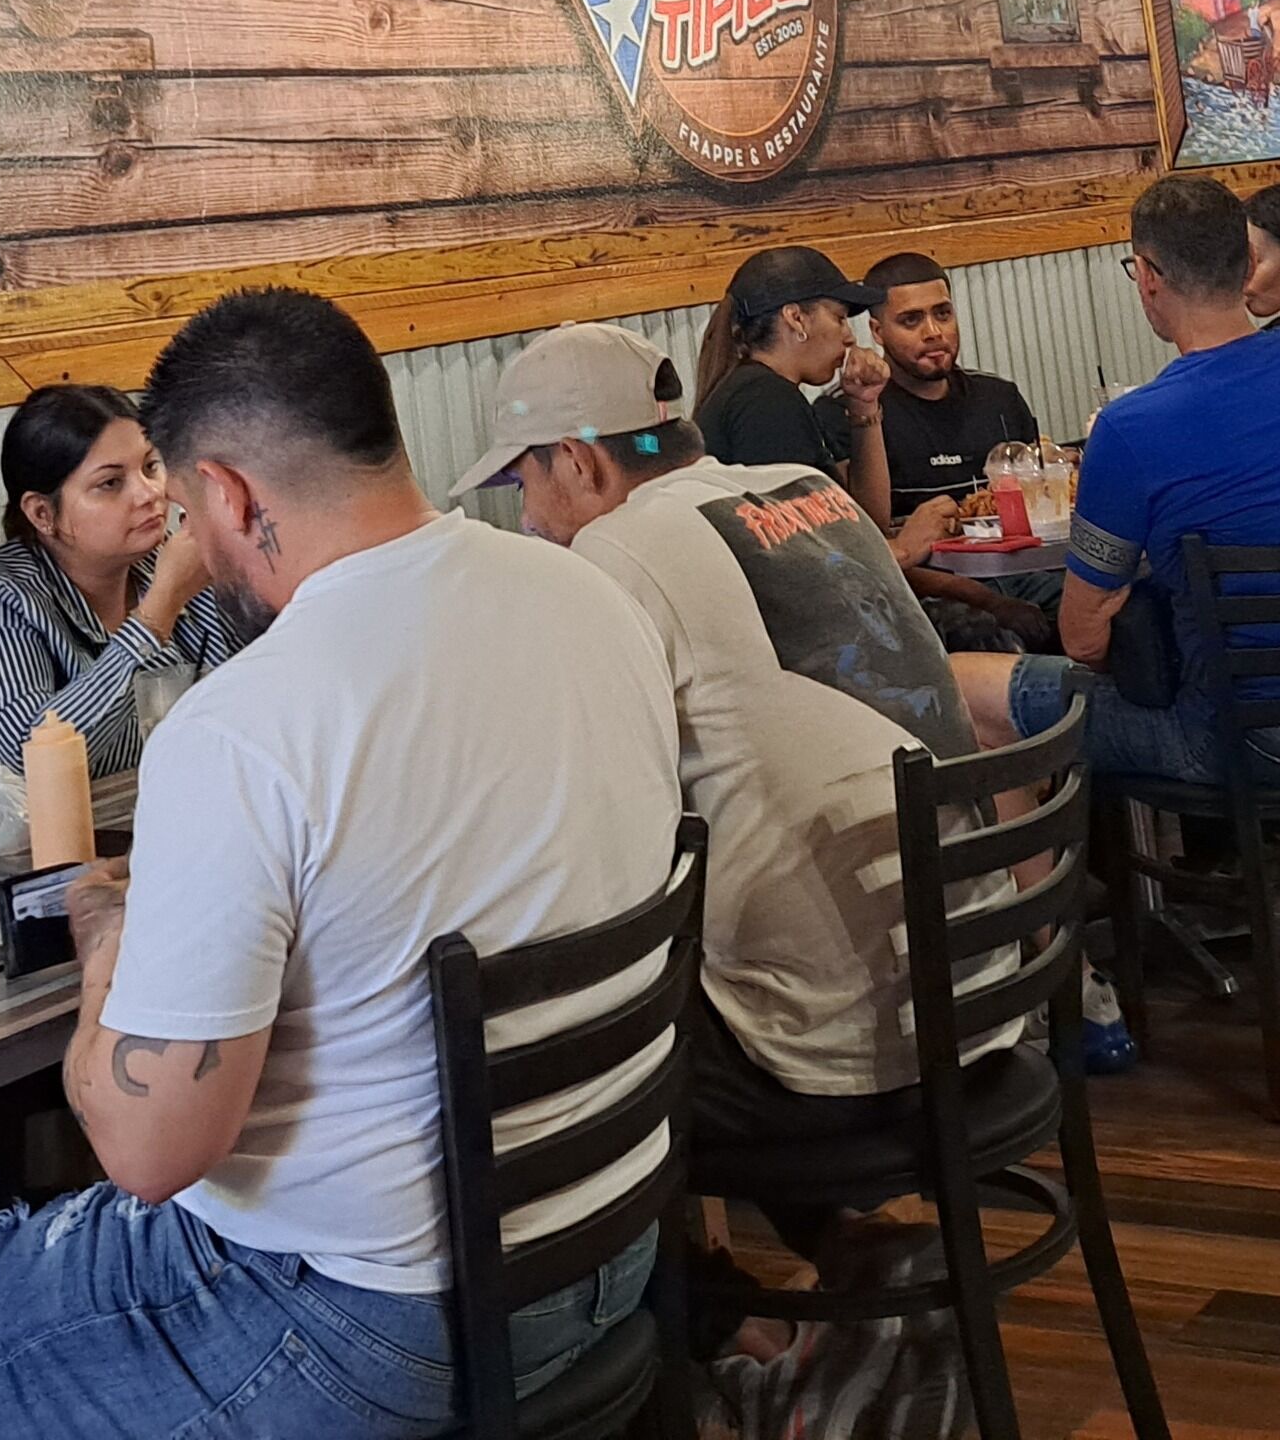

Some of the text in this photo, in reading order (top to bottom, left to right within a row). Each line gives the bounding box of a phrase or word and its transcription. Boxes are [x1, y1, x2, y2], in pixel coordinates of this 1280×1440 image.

[754, 33, 777, 57] EST.
[679, 20, 830, 168] FRAPPE & RESTAURANTE
[930, 454, 962, 466] adidas
